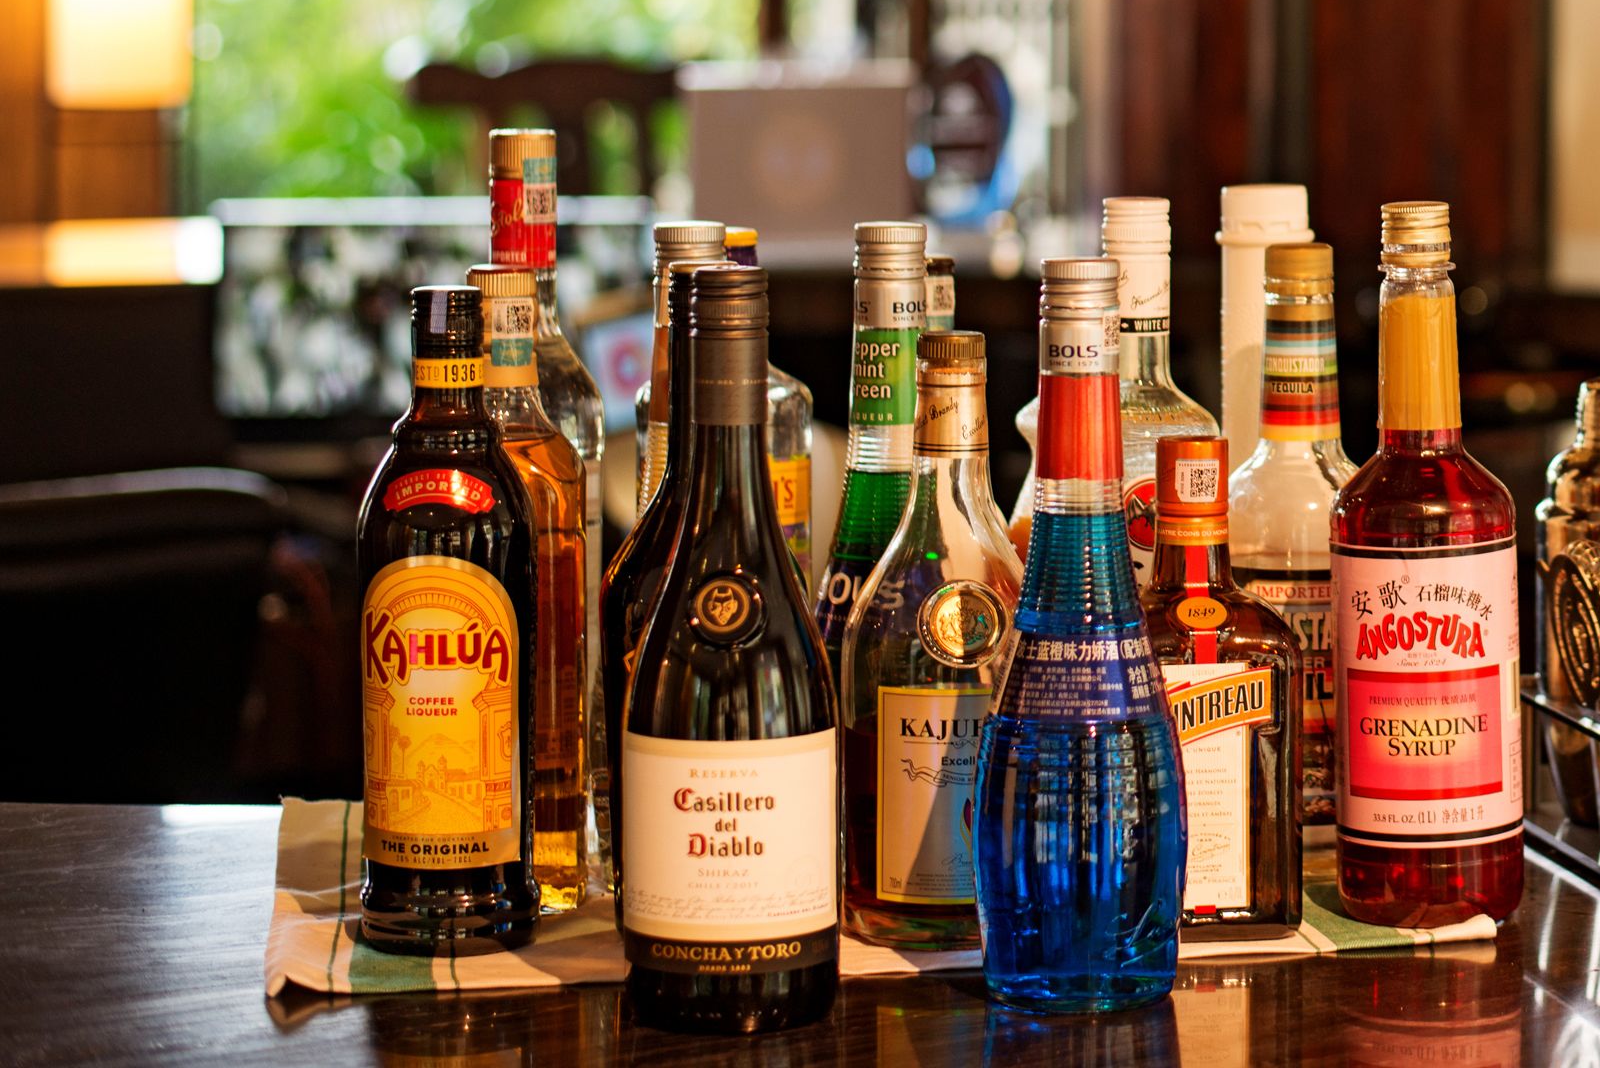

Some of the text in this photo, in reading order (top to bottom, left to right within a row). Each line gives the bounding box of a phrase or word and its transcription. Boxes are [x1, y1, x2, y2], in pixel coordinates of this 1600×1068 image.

[1134, 319, 1161, 331] WHITE
[1049, 344, 1098, 359] BOLS
[443, 363, 476, 383] 1936
[1271, 382, 1314, 393] TEQUILA
[1415, 583, 1493, 621] 石榴味糖水
[1187, 606, 1216, 618] 1849
[1355, 611, 1486, 660] ANGOSTURA
[365, 609, 510, 685] KAHLÚA
[409, 697, 455, 706] COFFEE
[1369, 695, 1400, 707] PREMIUM
[1403, 695, 1438, 707] QUALITY
[406, 707, 458, 717] LIQUEUR
[1360, 713, 1489, 737] GRENADINE
[1388, 737, 1456, 757] SYRUP
[689, 768, 759, 779] RESERVA
[673, 787, 775, 812] Casillero
[715, 817, 737, 832] del
[381, 840, 490, 855] THE ORIGINAL
[687, 832, 764, 858] Diablo
[652, 940, 802, 962] CONCHA Y TORO
